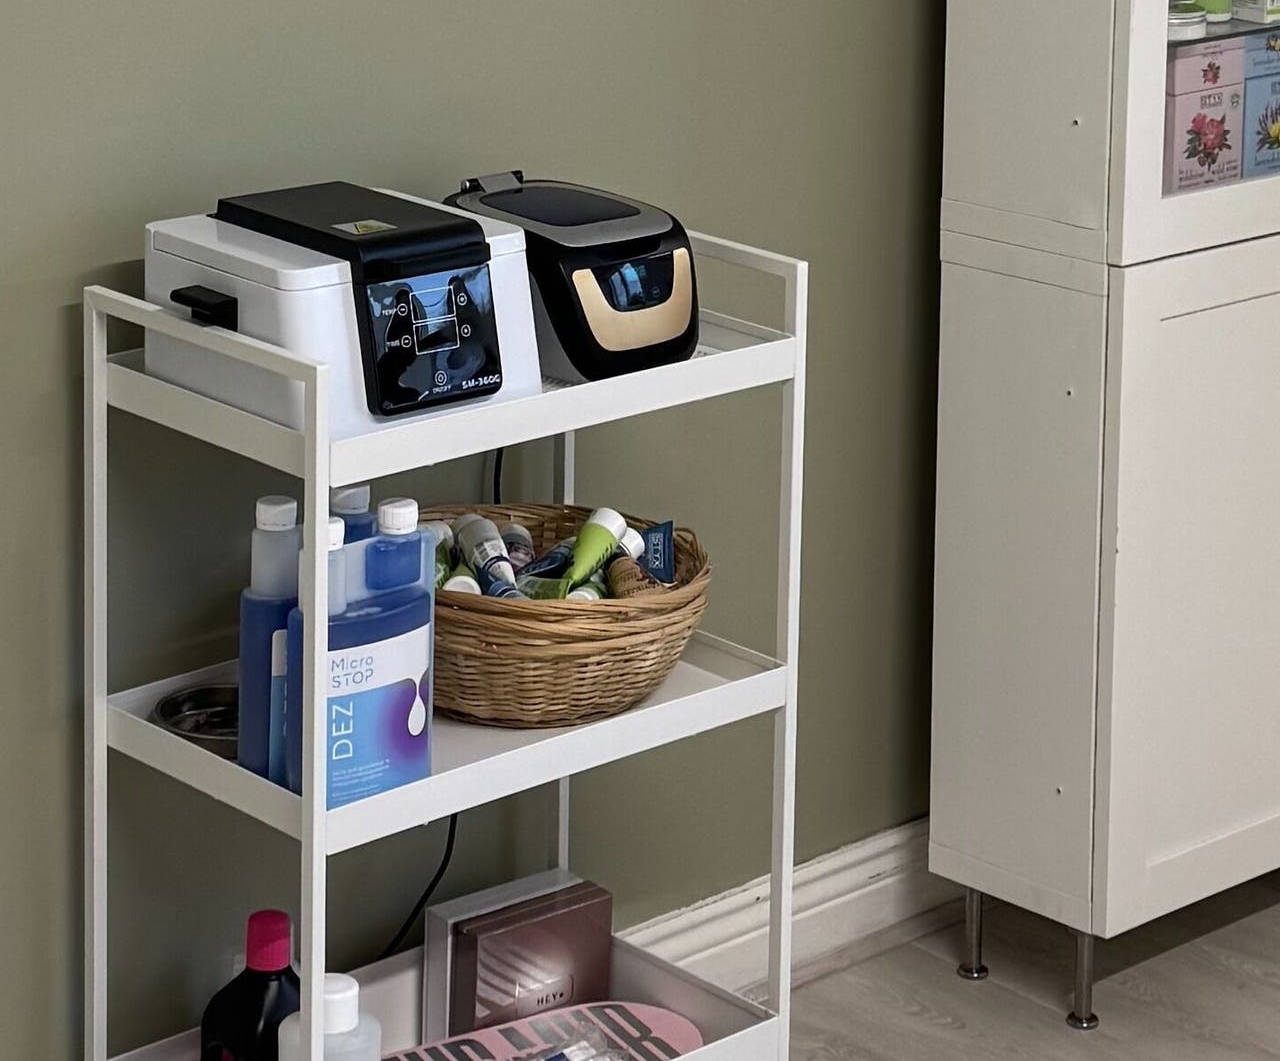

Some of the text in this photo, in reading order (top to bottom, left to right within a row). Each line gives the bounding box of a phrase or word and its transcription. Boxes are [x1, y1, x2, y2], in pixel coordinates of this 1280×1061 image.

[331, 655, 374, 673] Micro
[331, 668, 374, 689] STOP
[331, 700, 354, 761] DEZ
[537, 992, 559, 1006] HEY
